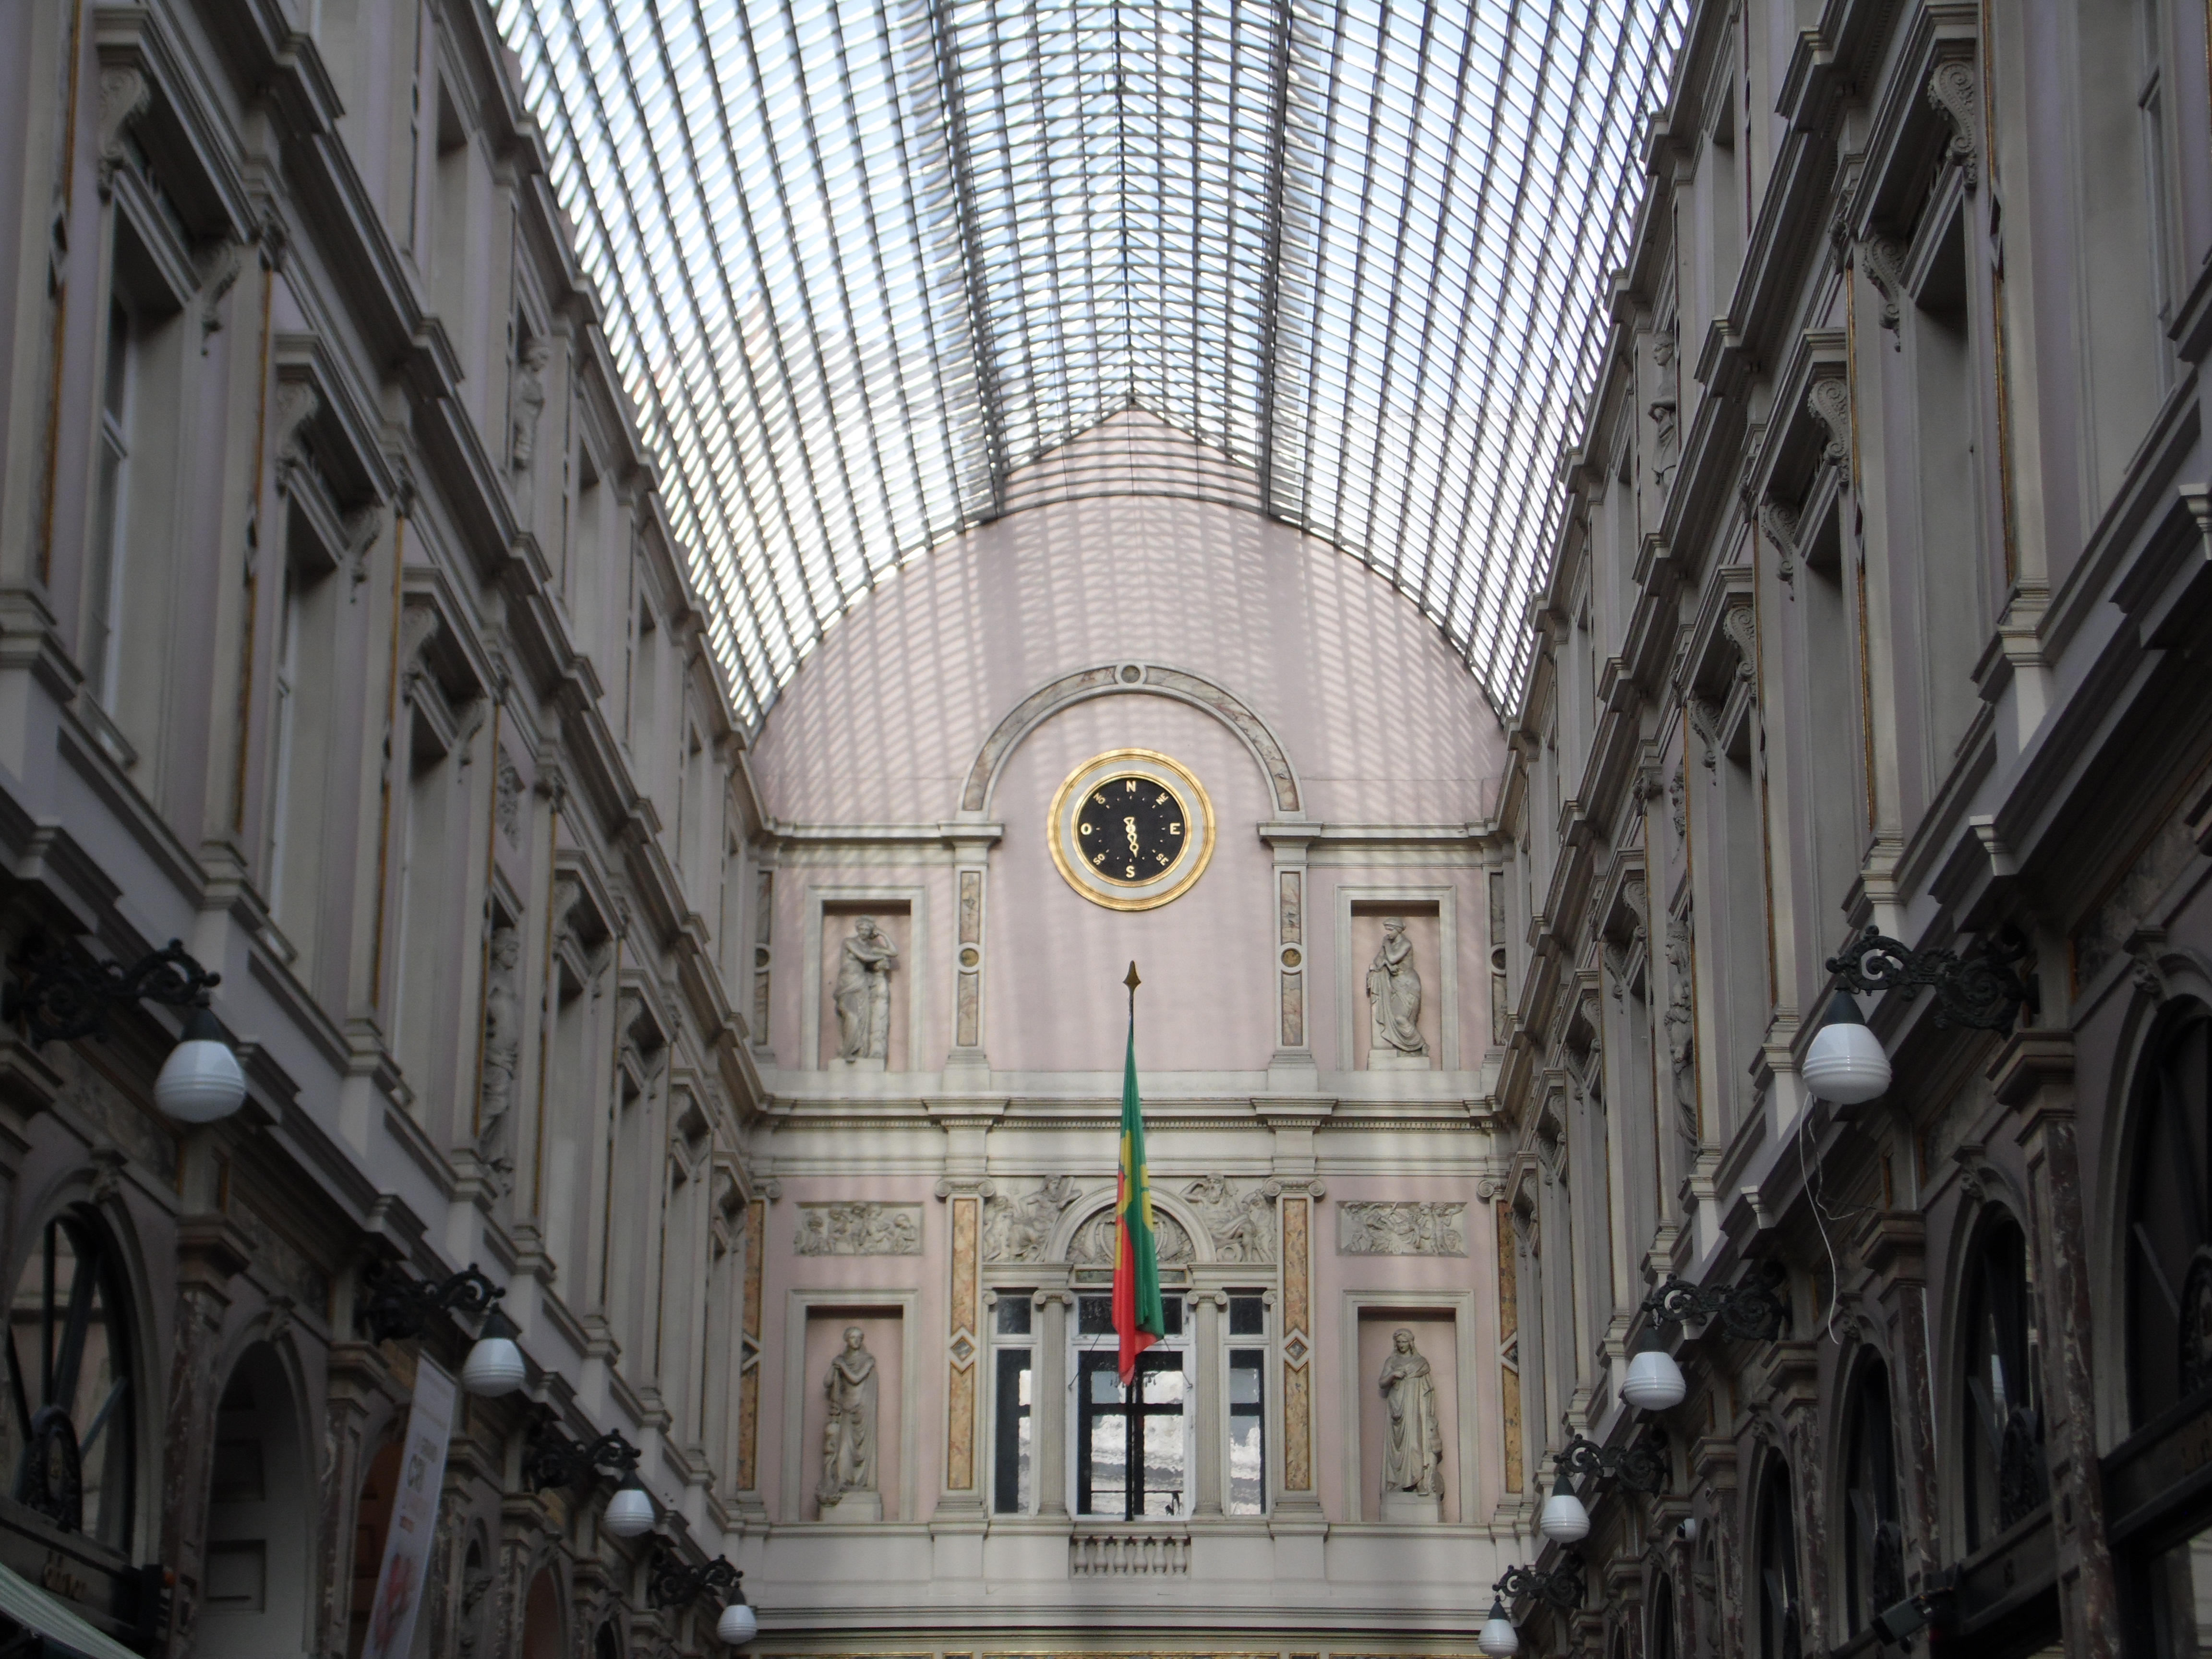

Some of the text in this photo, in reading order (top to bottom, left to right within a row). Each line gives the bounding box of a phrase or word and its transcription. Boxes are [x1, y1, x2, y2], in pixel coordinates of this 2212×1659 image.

[1126, 781, 1136, 792] N
[1093, 793, 1106, 804] NO
[1155, 793, 1169, 805] NE
[1081, 823, 1092, 835] O
[1170, 823, 1180, 835] E
[1093, 854, 1105, 865] SO
[1155, 854, 1169, 866] SE
[1126, 866, 1135, 878] S
